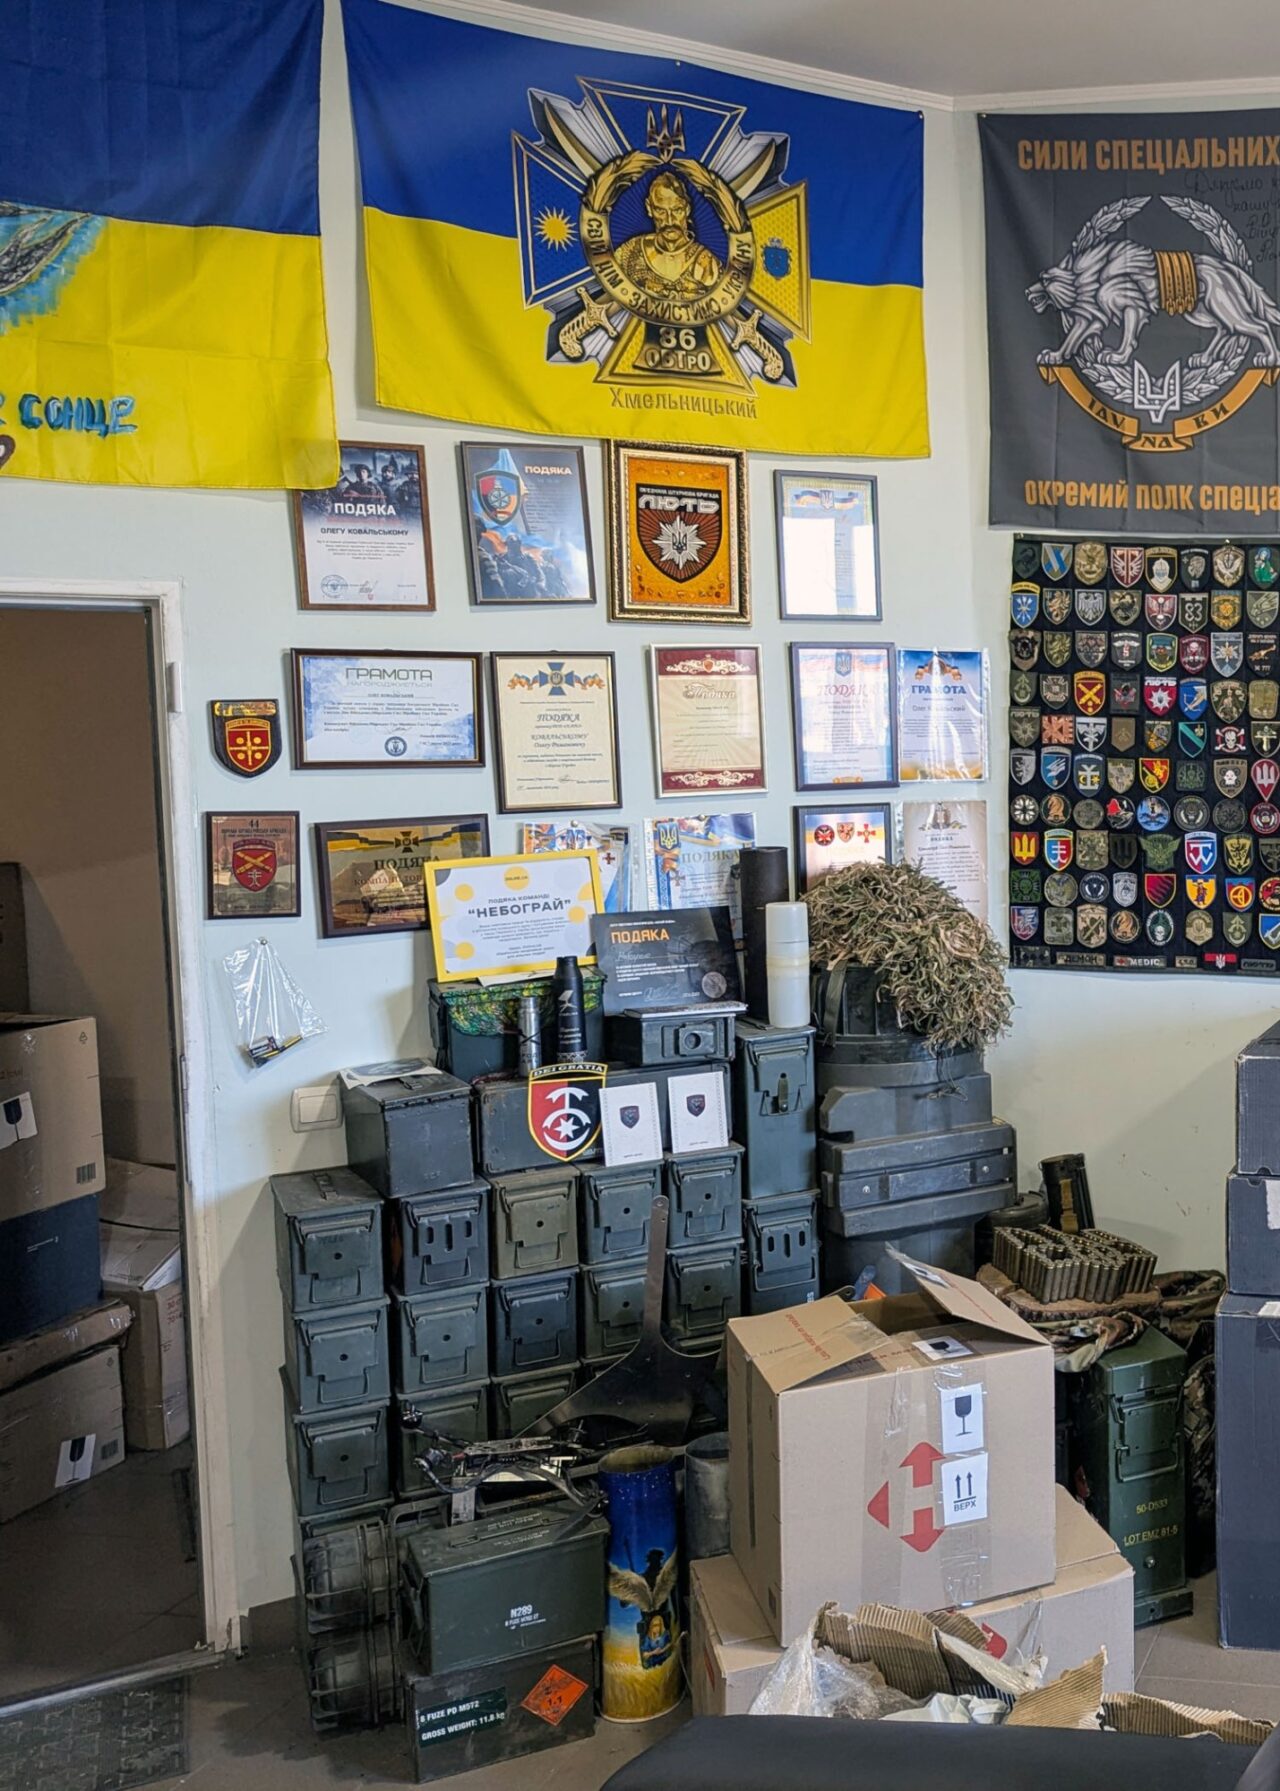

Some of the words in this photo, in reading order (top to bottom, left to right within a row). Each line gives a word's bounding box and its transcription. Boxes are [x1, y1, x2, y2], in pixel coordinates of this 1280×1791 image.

[1018, 139, 1088, 170] СИЛИ
[1095, 135, 1280, 175] СПЕЦІАЛЬНИХ
[658, 326, 698, 349] 86
[609, 387, 758, 420] Хмельницький
[18, 394, 138, 438] СОНЦЕ
[524, 465, 573, 476] ПОДЯКА
[334, 502, 397, 516] ПОДЯКА
[638, 494, 720, 514] ЛЮТЬ
[348, 528, 409, 536] КОВАЛЬСЬКОМУ
[345, 667, 433, 681] ГРАМОТА
[488, 896, 518, 904] ПОДЯКА
[610, 928, 670, 944] ПОДЯКА
[1130, 957, 1161, 966] MEDIC
[533, 1066, 557, 1077] DEI
[558, 1064, 603, 1072] GRATIA
[953, 1500, 977, 1512] ВЕРХ
[1123, 1532, 1141, 1547] LOT
[510, 1604, 533, 1619] N289
[427, 1709, 446, 1722] FUZE
[446, 1706, 457, 1716] PD
[421, 1728, 446, 1741] GROSS
[446, 1720, 478, 1734] WEIGHT:
